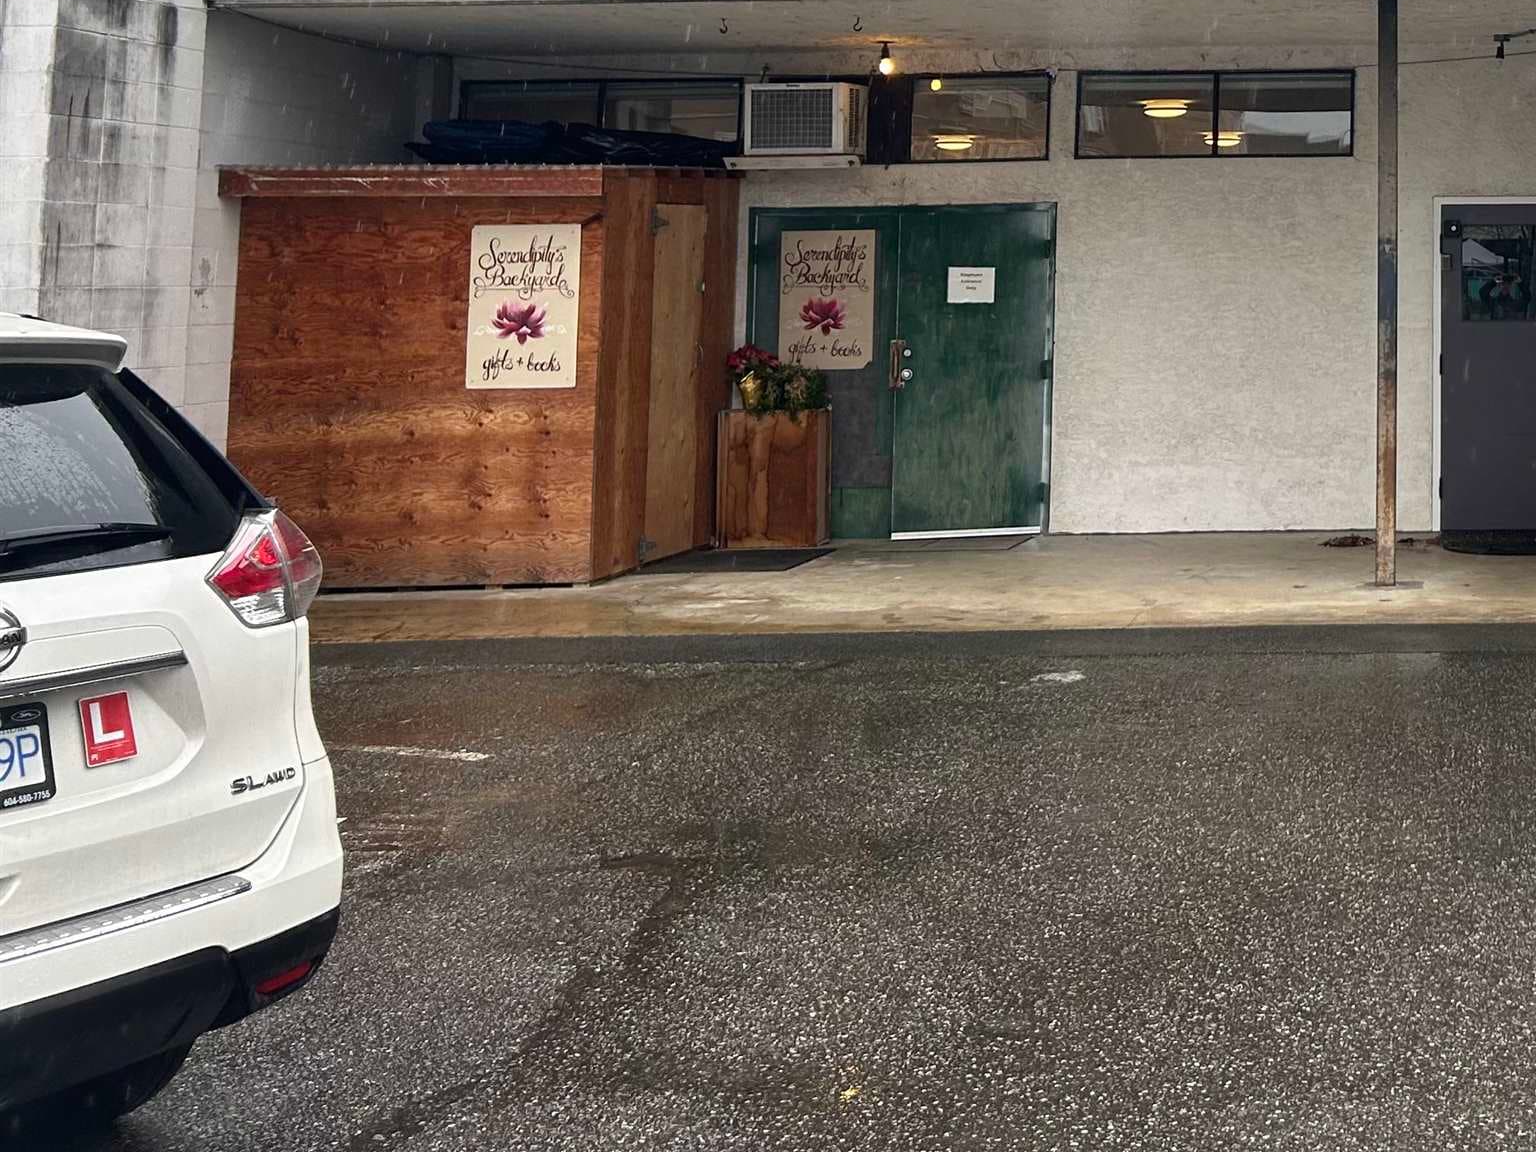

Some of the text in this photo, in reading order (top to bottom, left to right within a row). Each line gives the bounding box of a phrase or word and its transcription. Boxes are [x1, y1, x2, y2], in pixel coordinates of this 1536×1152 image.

[484, 264, 565, 298] Backyard
[790, 261, 864, 296] Backyard
[482, 348, 514, 381] gifts
[527, 351, 561, 372] books
[89, 702, 125, 745] L
[230, 767, 296, 795] SL AWD
